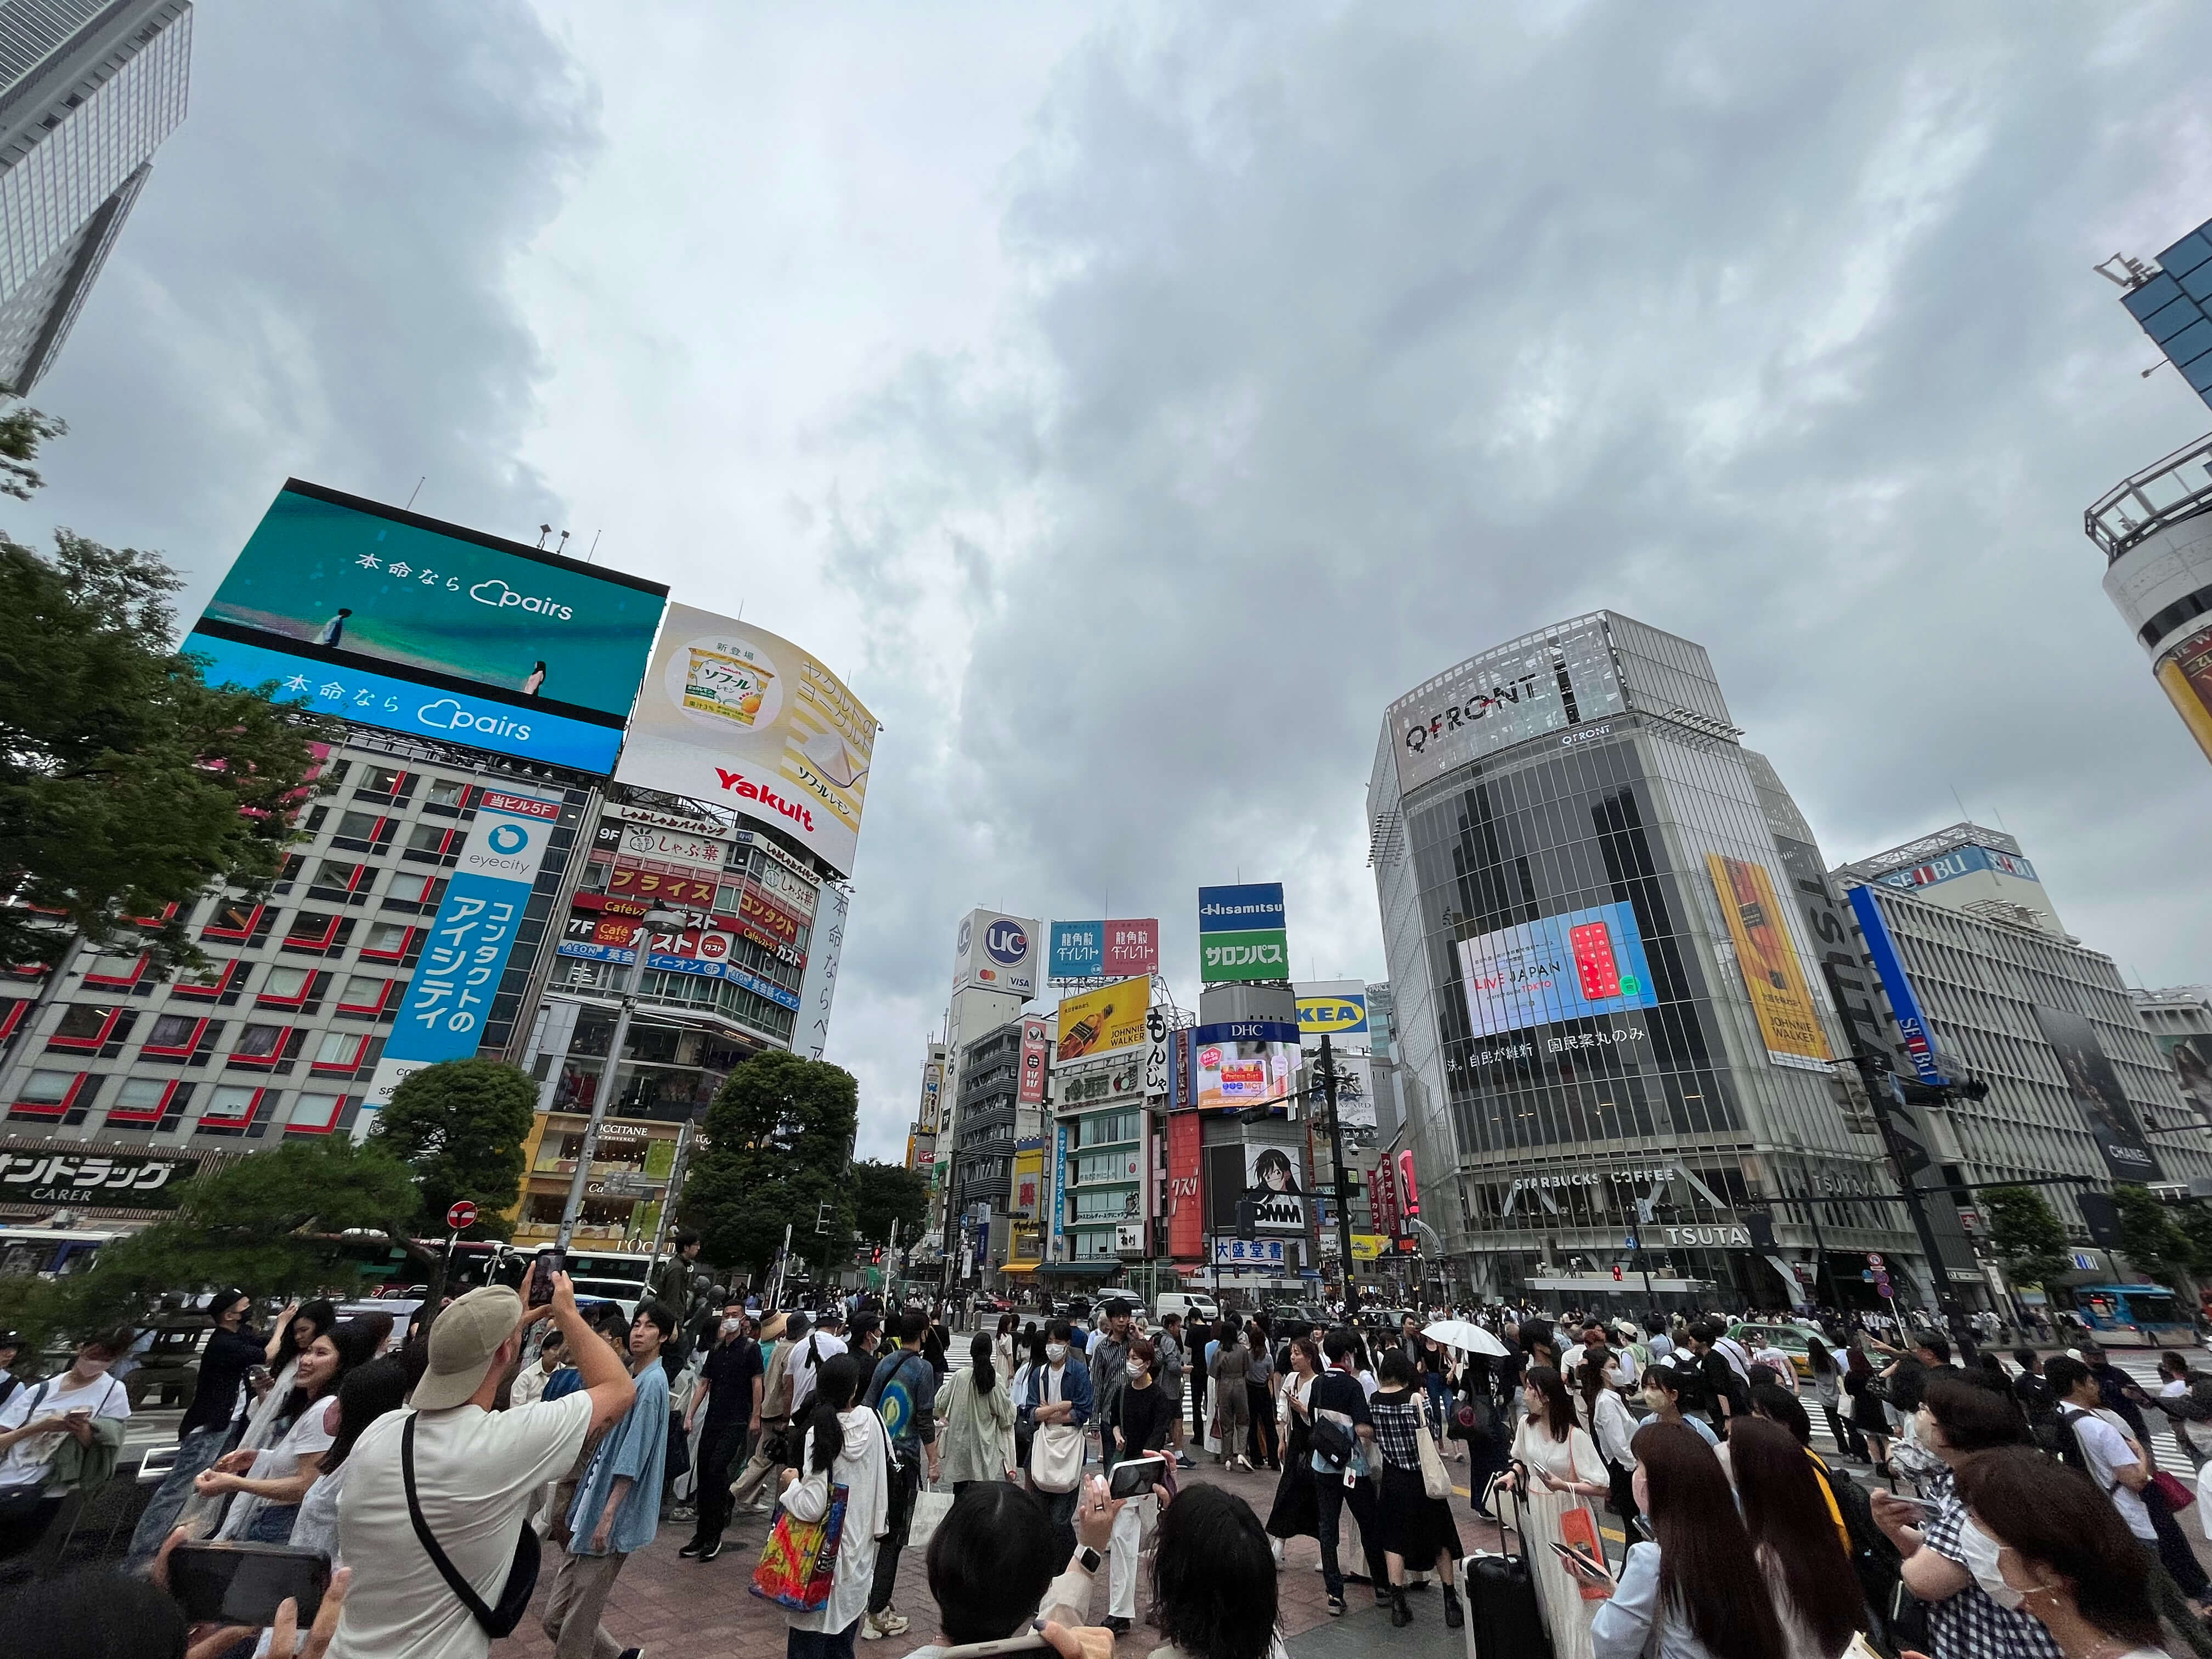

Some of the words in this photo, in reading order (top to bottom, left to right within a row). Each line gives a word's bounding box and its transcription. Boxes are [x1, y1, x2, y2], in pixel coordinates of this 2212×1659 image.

[355, 553, 460, 592] 本命なら
[501, 590, 573, 622] pairs
[716, 643, 754, 661] 新登場
[705, 669, 751, 690] ソフール
[282, 674, 399, 713] 本命なら
[450, 703, 532, 741] pairs
[803, 661, 874, 739] ヤクルトの
[797, 678, 871, 753] ヨーグルト
[1406, 674, 1537, 755] QFRONT
[1562, 724, 1611, 746] QFRONT
[489, 794, 552, 815] 当ビル5F
[714, 767, 814, 833] Yakult
[621, 808, 728, 837] しゃぶしゃぶバイキング
[599, 827, 621, 841] 9F
[658, 835, 720, 861] しゃぶ葉
[469, 853, 530, 874] eyecity
[1887, 855, 1967, 890] SEIBU
[612, 870, 713, 902] プライス
[740, 894, 795, 935] コンタクト
[1200, 902, 1283, 916] Hisamitsu
[569, 918, 596, 934] 7F
[600, 923, 629, 937] Café
[598, 934, 626, 944] レストラン
[988, 927, 1026, 956] UC
[1062, 932, 1093, 947] 龍角散
[1116, 930, 1148, 945] 龍角散
[565, 944, 597, 956] AEON
[607, 949, 701, 971] 英会イーオン
[776, 944, 802, 967] ガスト
[1205, 943, 1284, 967] サロンパス
[414, 896, 486, 1029] アイシティ
[448, 902, 514, 1032] コンタクトの
[1009, 977, 1030, 988] VISA
[1475, 972, 1505, 990] LIVE
[1509, 961, 1561, 983] JAPAN
[1521, 980, 1551, 992] TOKYO
[1296, 1006, 1357, 1023] KEA
[1771, 1017, 1813, 1032] JOHNNIE
[1110, 1024, 1145, 1039] JOHNNIE
[1110, 1032, 1145, 1047] WALKER
[1231, 1024, 1263, 1037] DHC
[1147, 1008, 1167, 1092] もんじゃ
[1383, 1158, 1395, 1200] カラオケ
[1514, 1172, 1601, 1190] STARBUCKS
[1611, 1169, 1676, 1184] COFFEE
[30, 1188, 93, 1202] CARER
[1254, 1202, 1302, 1223] DMM
[1372, 1202, 1381, 1235] カラオ
[1665, 1226, 1751, 1247] TSUTA
[1217, 1241, 1283, 1260] 大盛堂書
